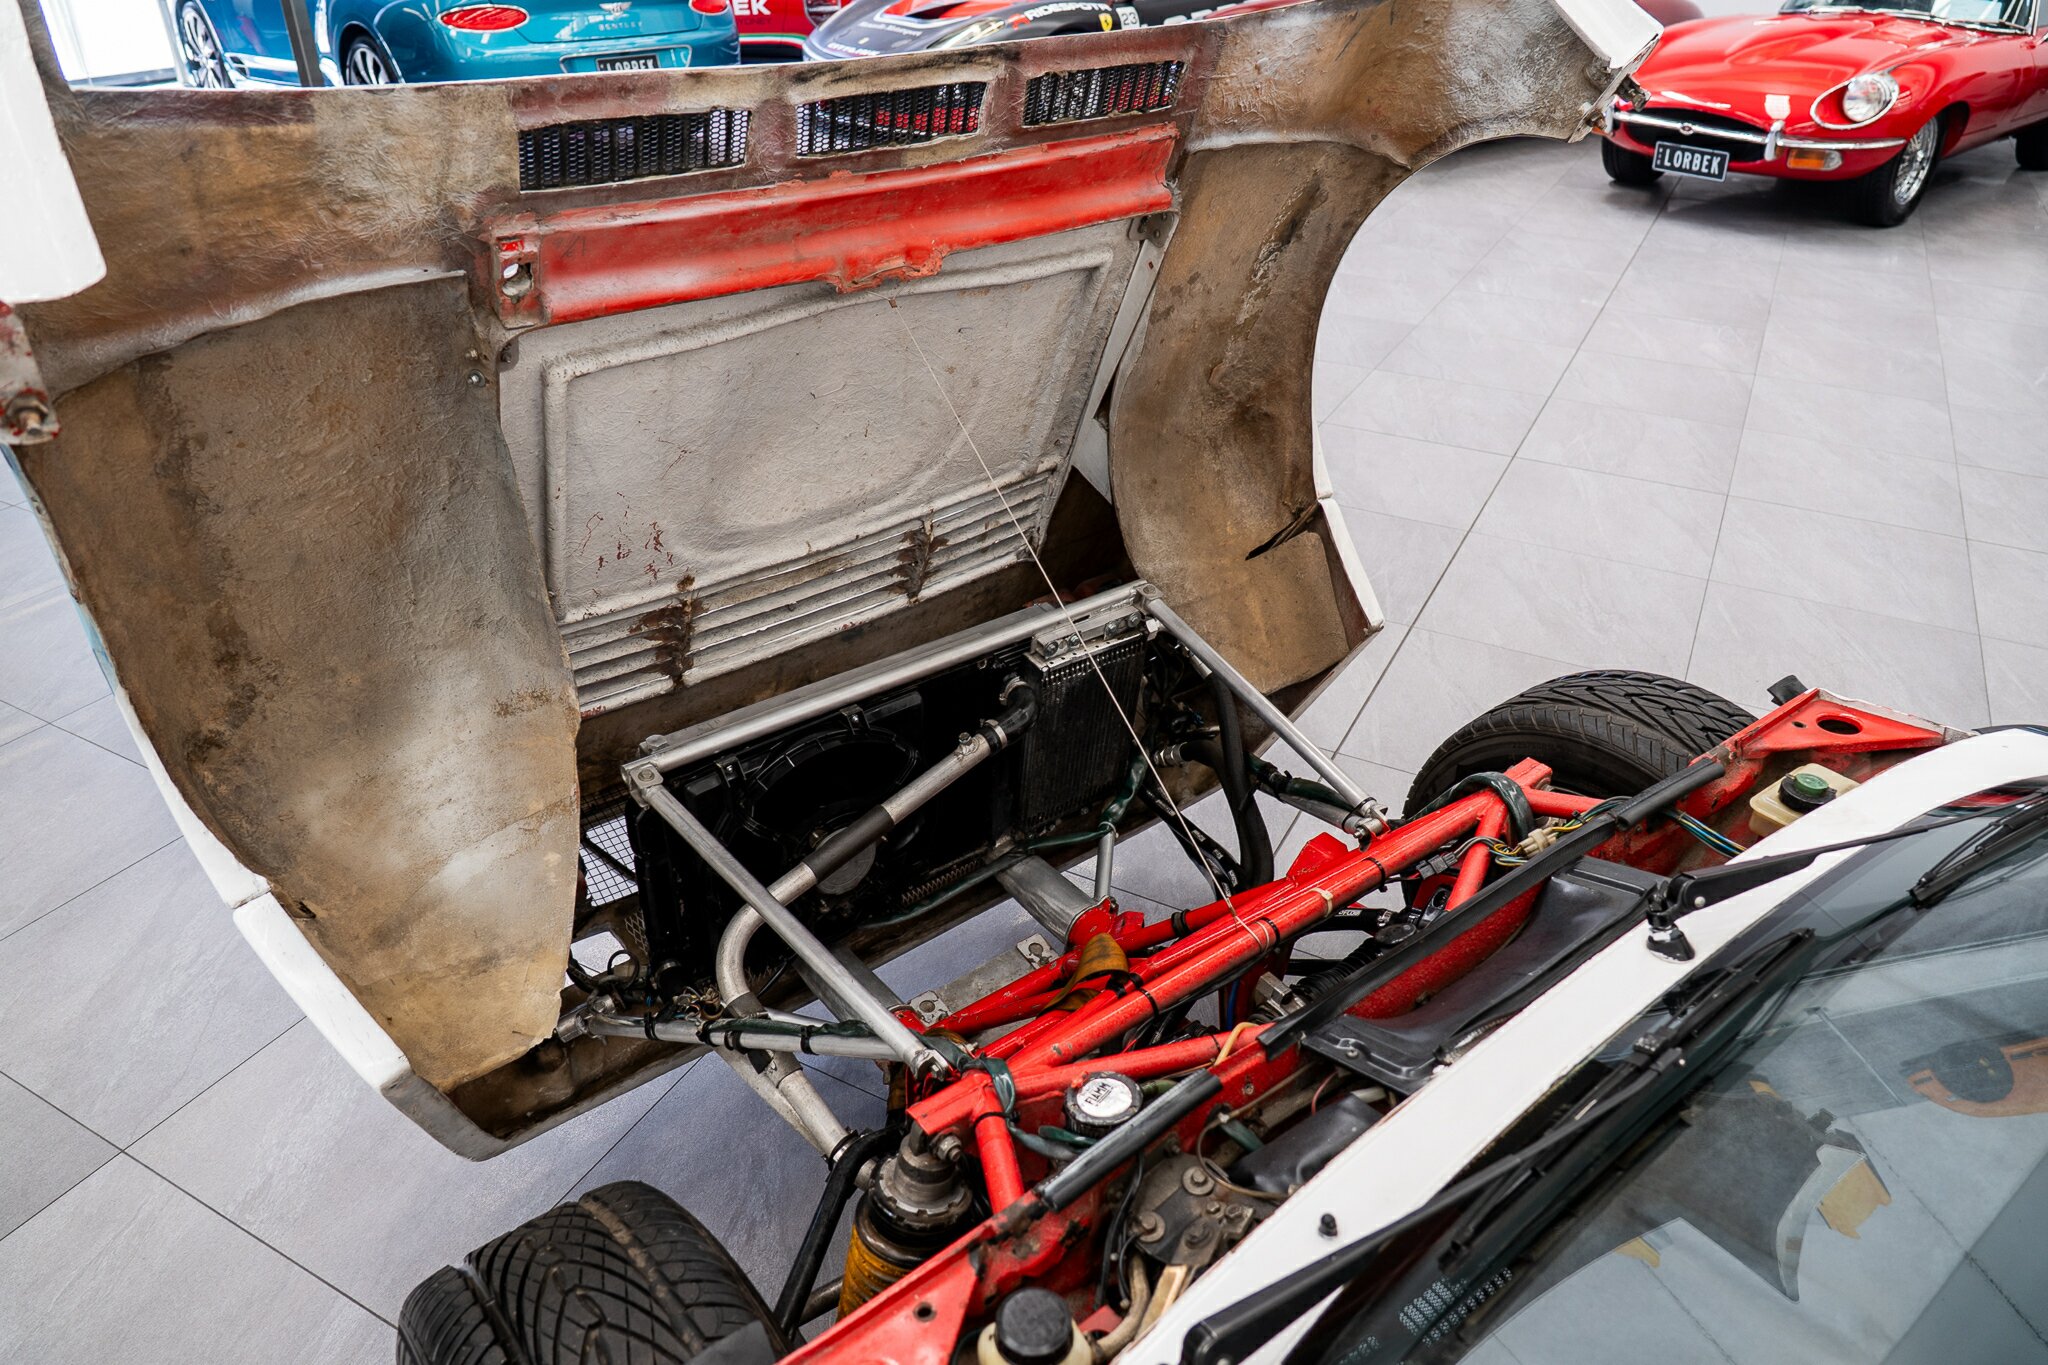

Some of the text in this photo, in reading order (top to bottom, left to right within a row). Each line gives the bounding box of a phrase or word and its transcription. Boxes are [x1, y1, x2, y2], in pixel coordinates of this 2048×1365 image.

[1121, 12, 1138, 26] 23
[1664, 148, 1721, 175] LORBEK
[1084, 1082, 1111, 1104] FIAMM
